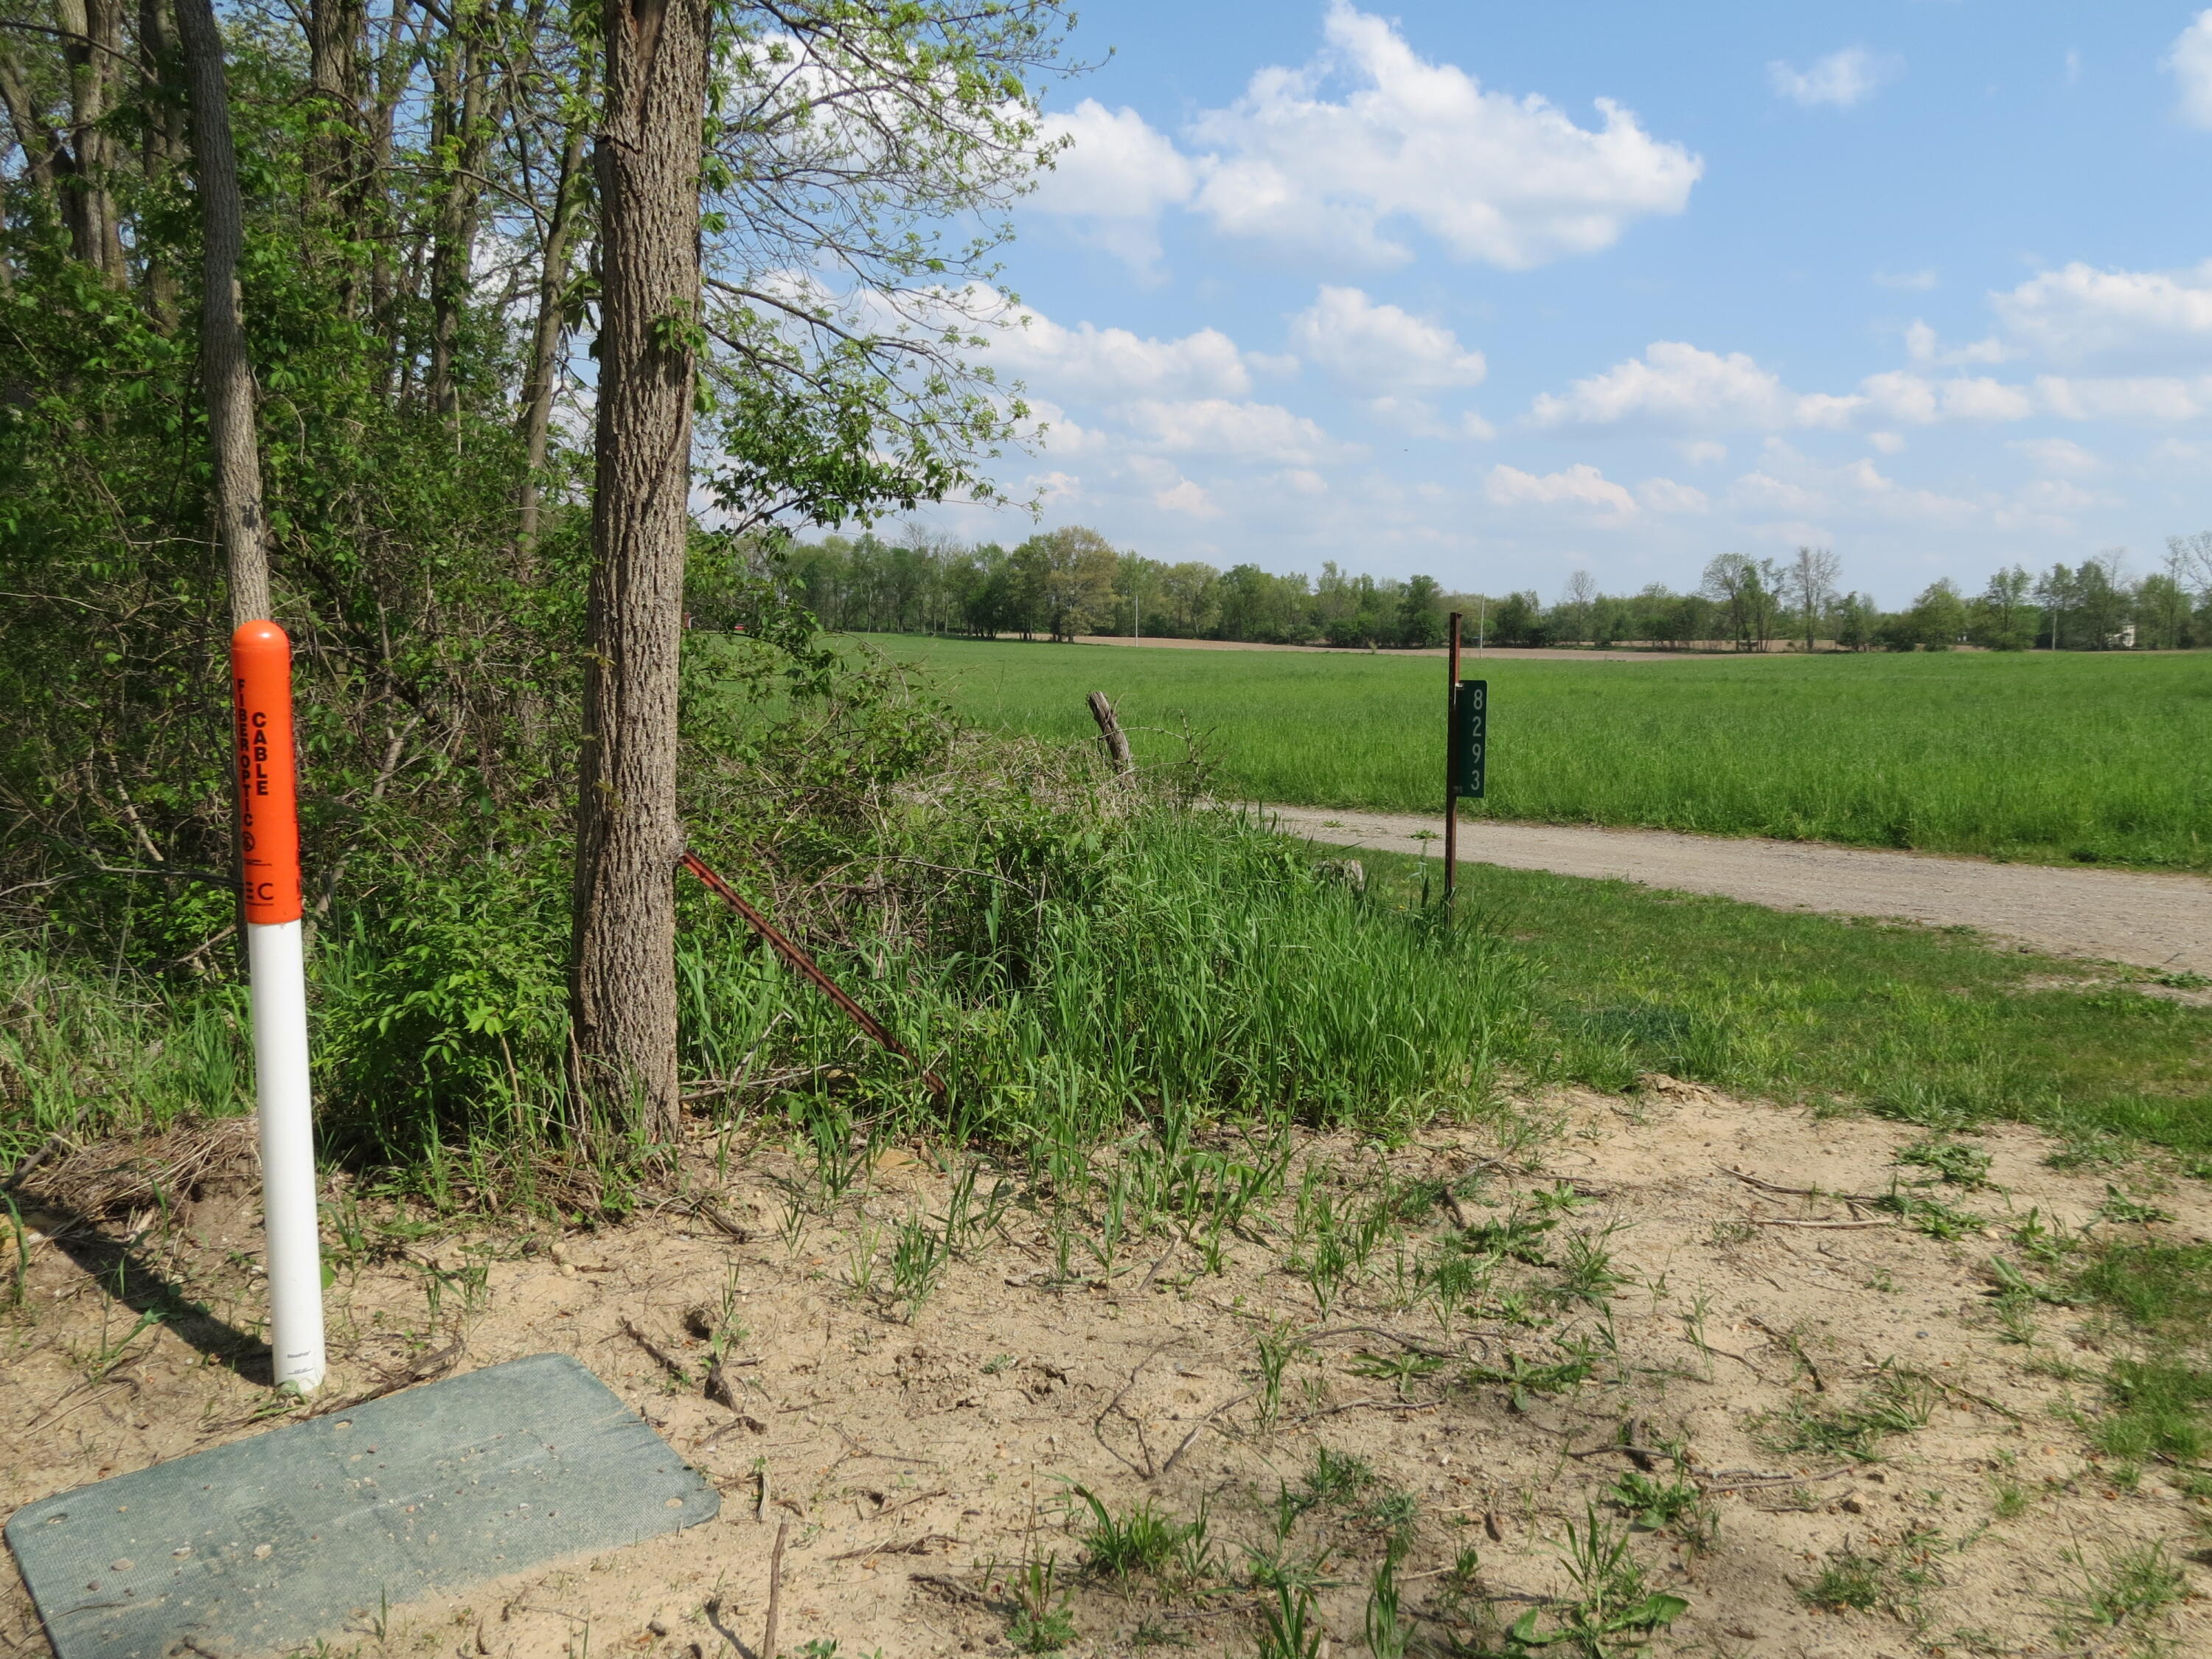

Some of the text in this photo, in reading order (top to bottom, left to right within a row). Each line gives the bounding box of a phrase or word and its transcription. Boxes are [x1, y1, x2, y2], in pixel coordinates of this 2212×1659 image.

[237, 679, 253, 827] FIBER OPTIC
[252, 712, 268, 796] CABLE
[1471, 689, 1483, 790] 8293
[246, 882, 274, 900] EC
